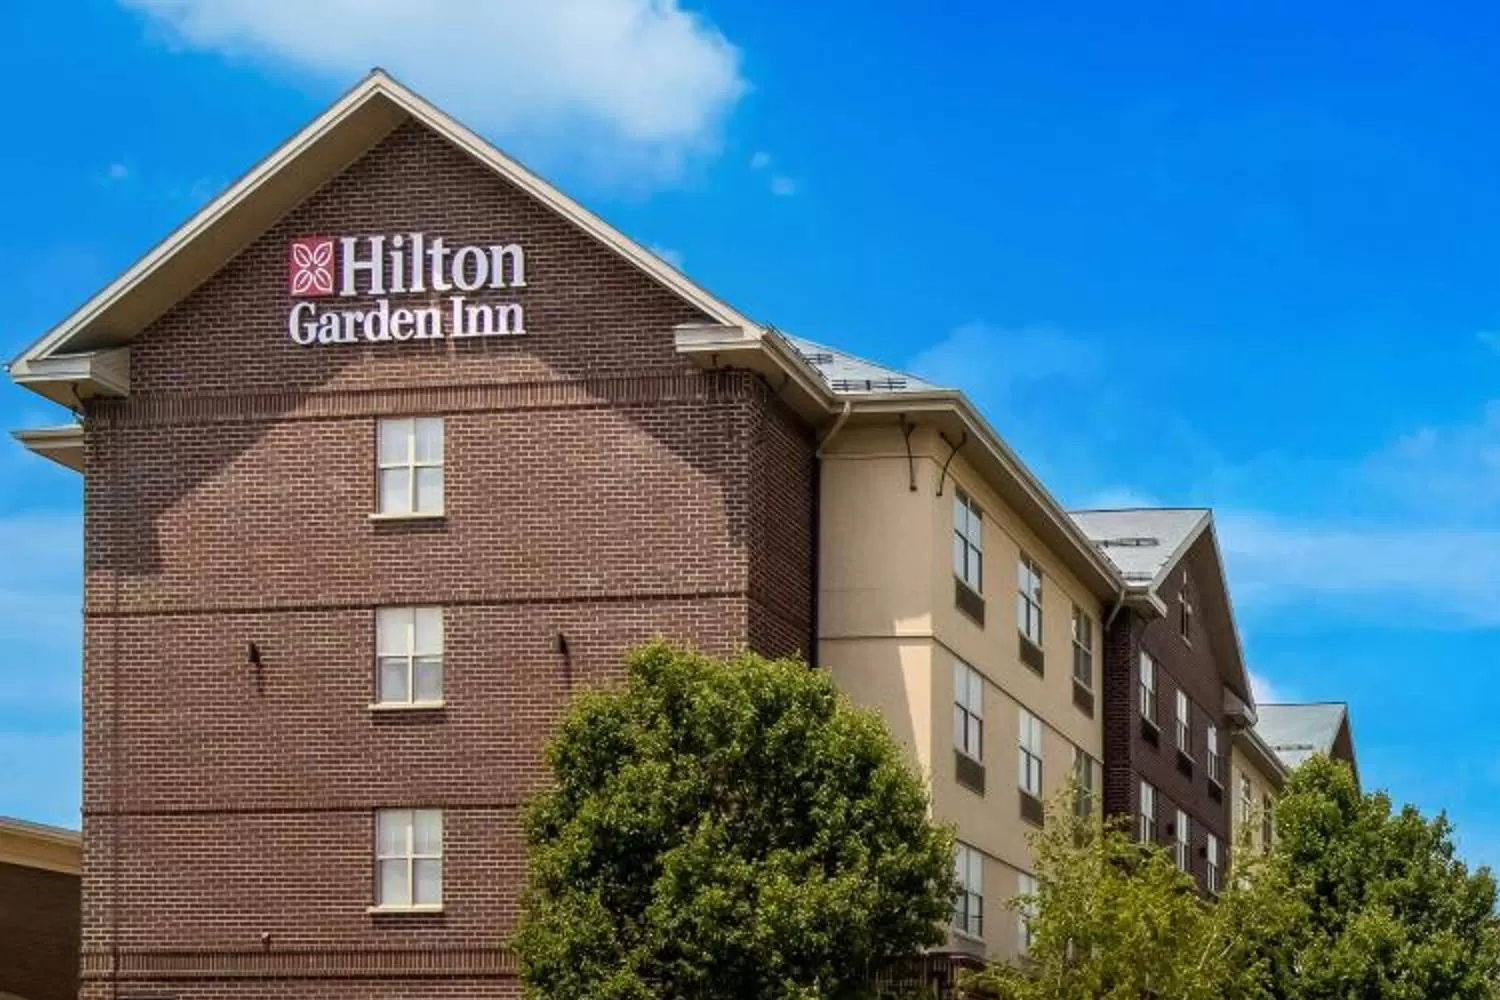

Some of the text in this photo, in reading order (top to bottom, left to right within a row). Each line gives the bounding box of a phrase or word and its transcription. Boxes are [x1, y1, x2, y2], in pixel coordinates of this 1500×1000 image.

[339, 232, 528, 296] Hilton
[289, 296, 527, 345] Garden Inn
